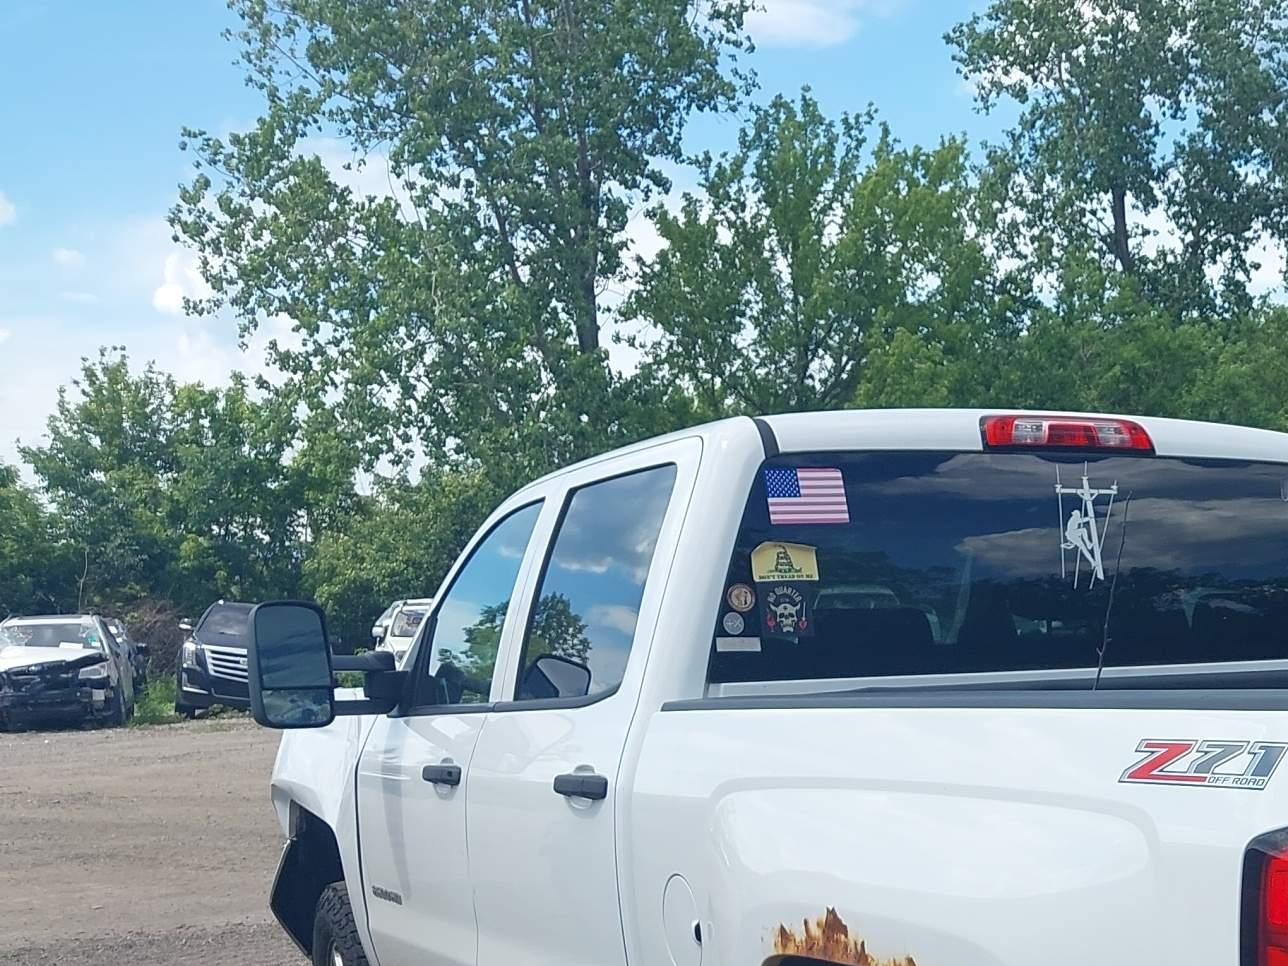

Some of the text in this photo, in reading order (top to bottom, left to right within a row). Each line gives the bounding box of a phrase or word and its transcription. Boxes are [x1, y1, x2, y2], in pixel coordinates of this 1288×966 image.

[774, 586, 803, 603] QUARTER
[1207, 776, 1266, 787] OFF ROAD
